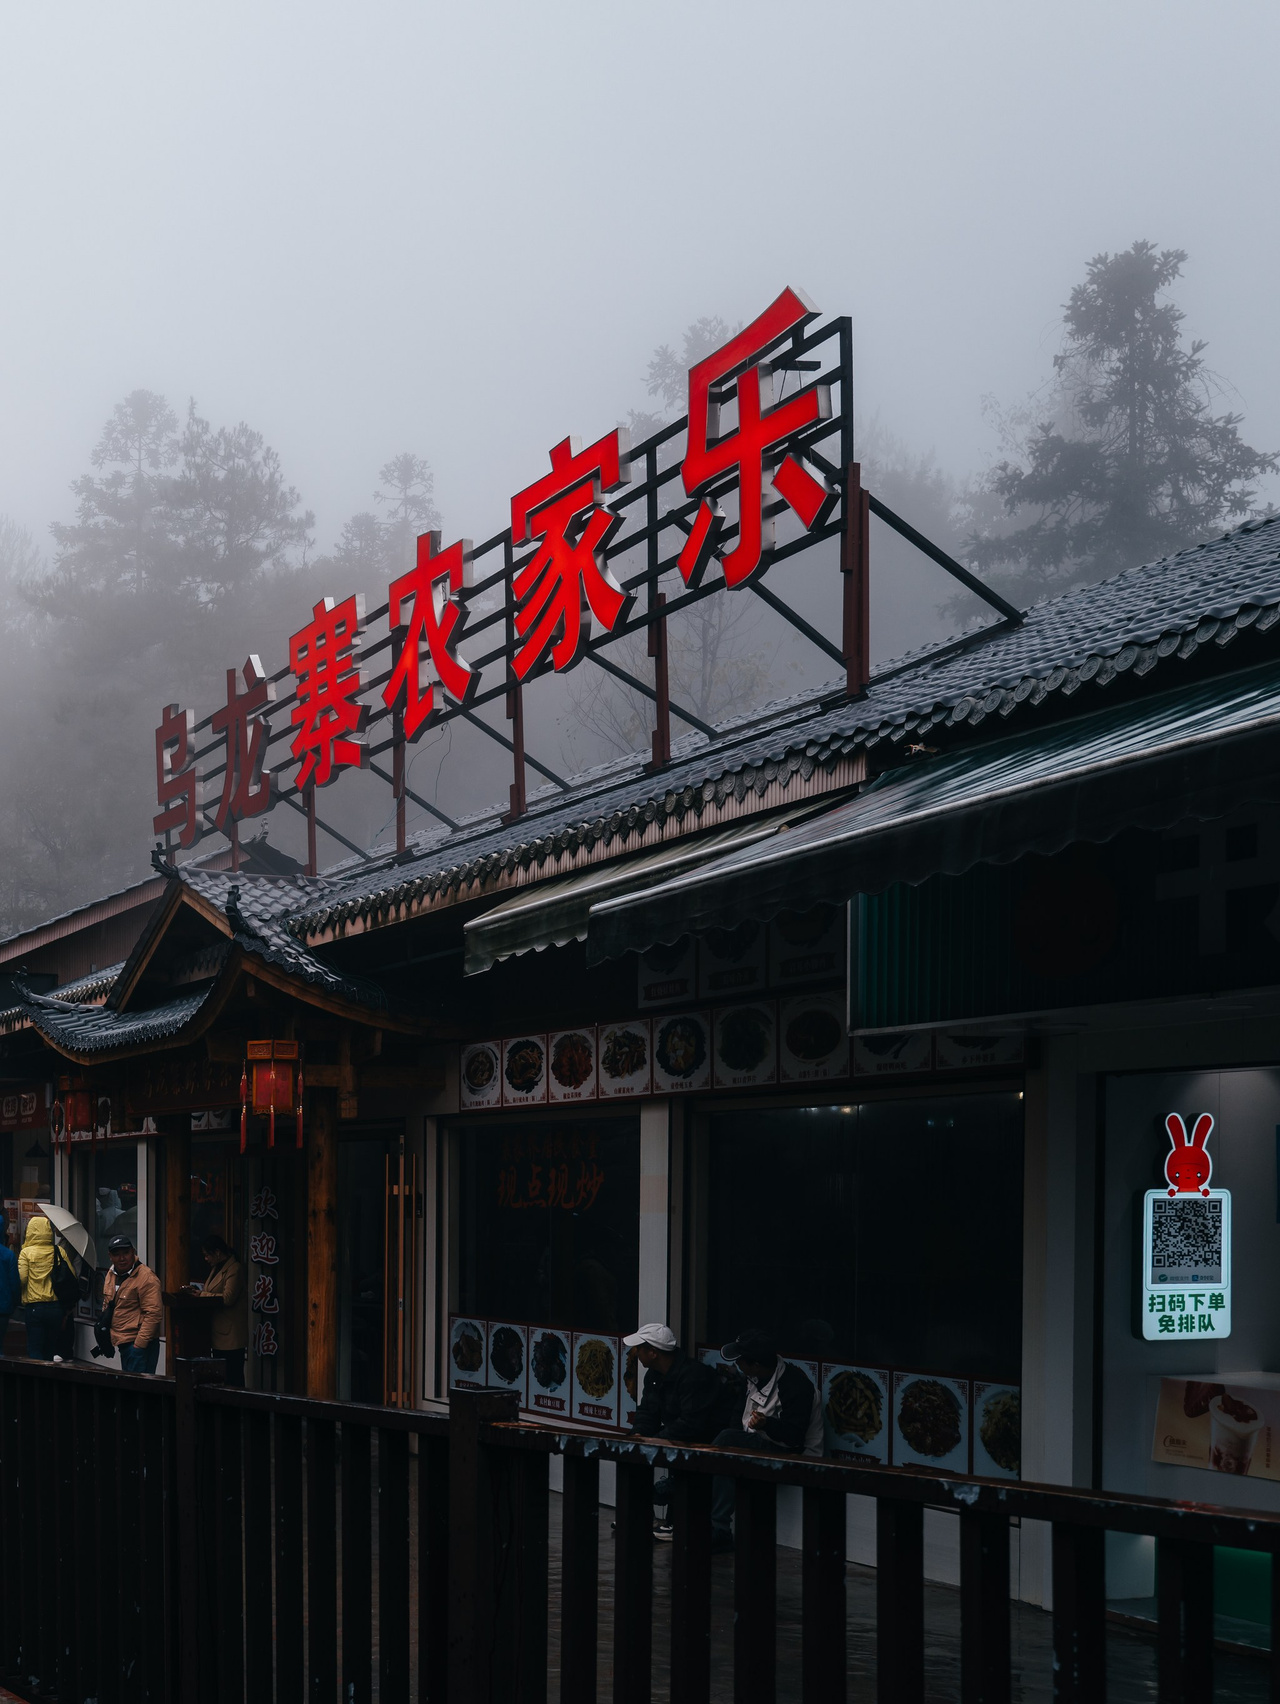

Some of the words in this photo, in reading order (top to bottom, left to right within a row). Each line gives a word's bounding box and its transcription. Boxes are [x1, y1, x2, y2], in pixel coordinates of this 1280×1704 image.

[153, 286, 837, 849] 乌龙寨农家乐
[496, 1160, 605, 1211] 现点现炒
[251, 1185, 280, 1357] 欢迎光临
[1148, 1293, 1226, 1313] 扫码下单
[1158, 1313, 1216, 1334] 免排队
